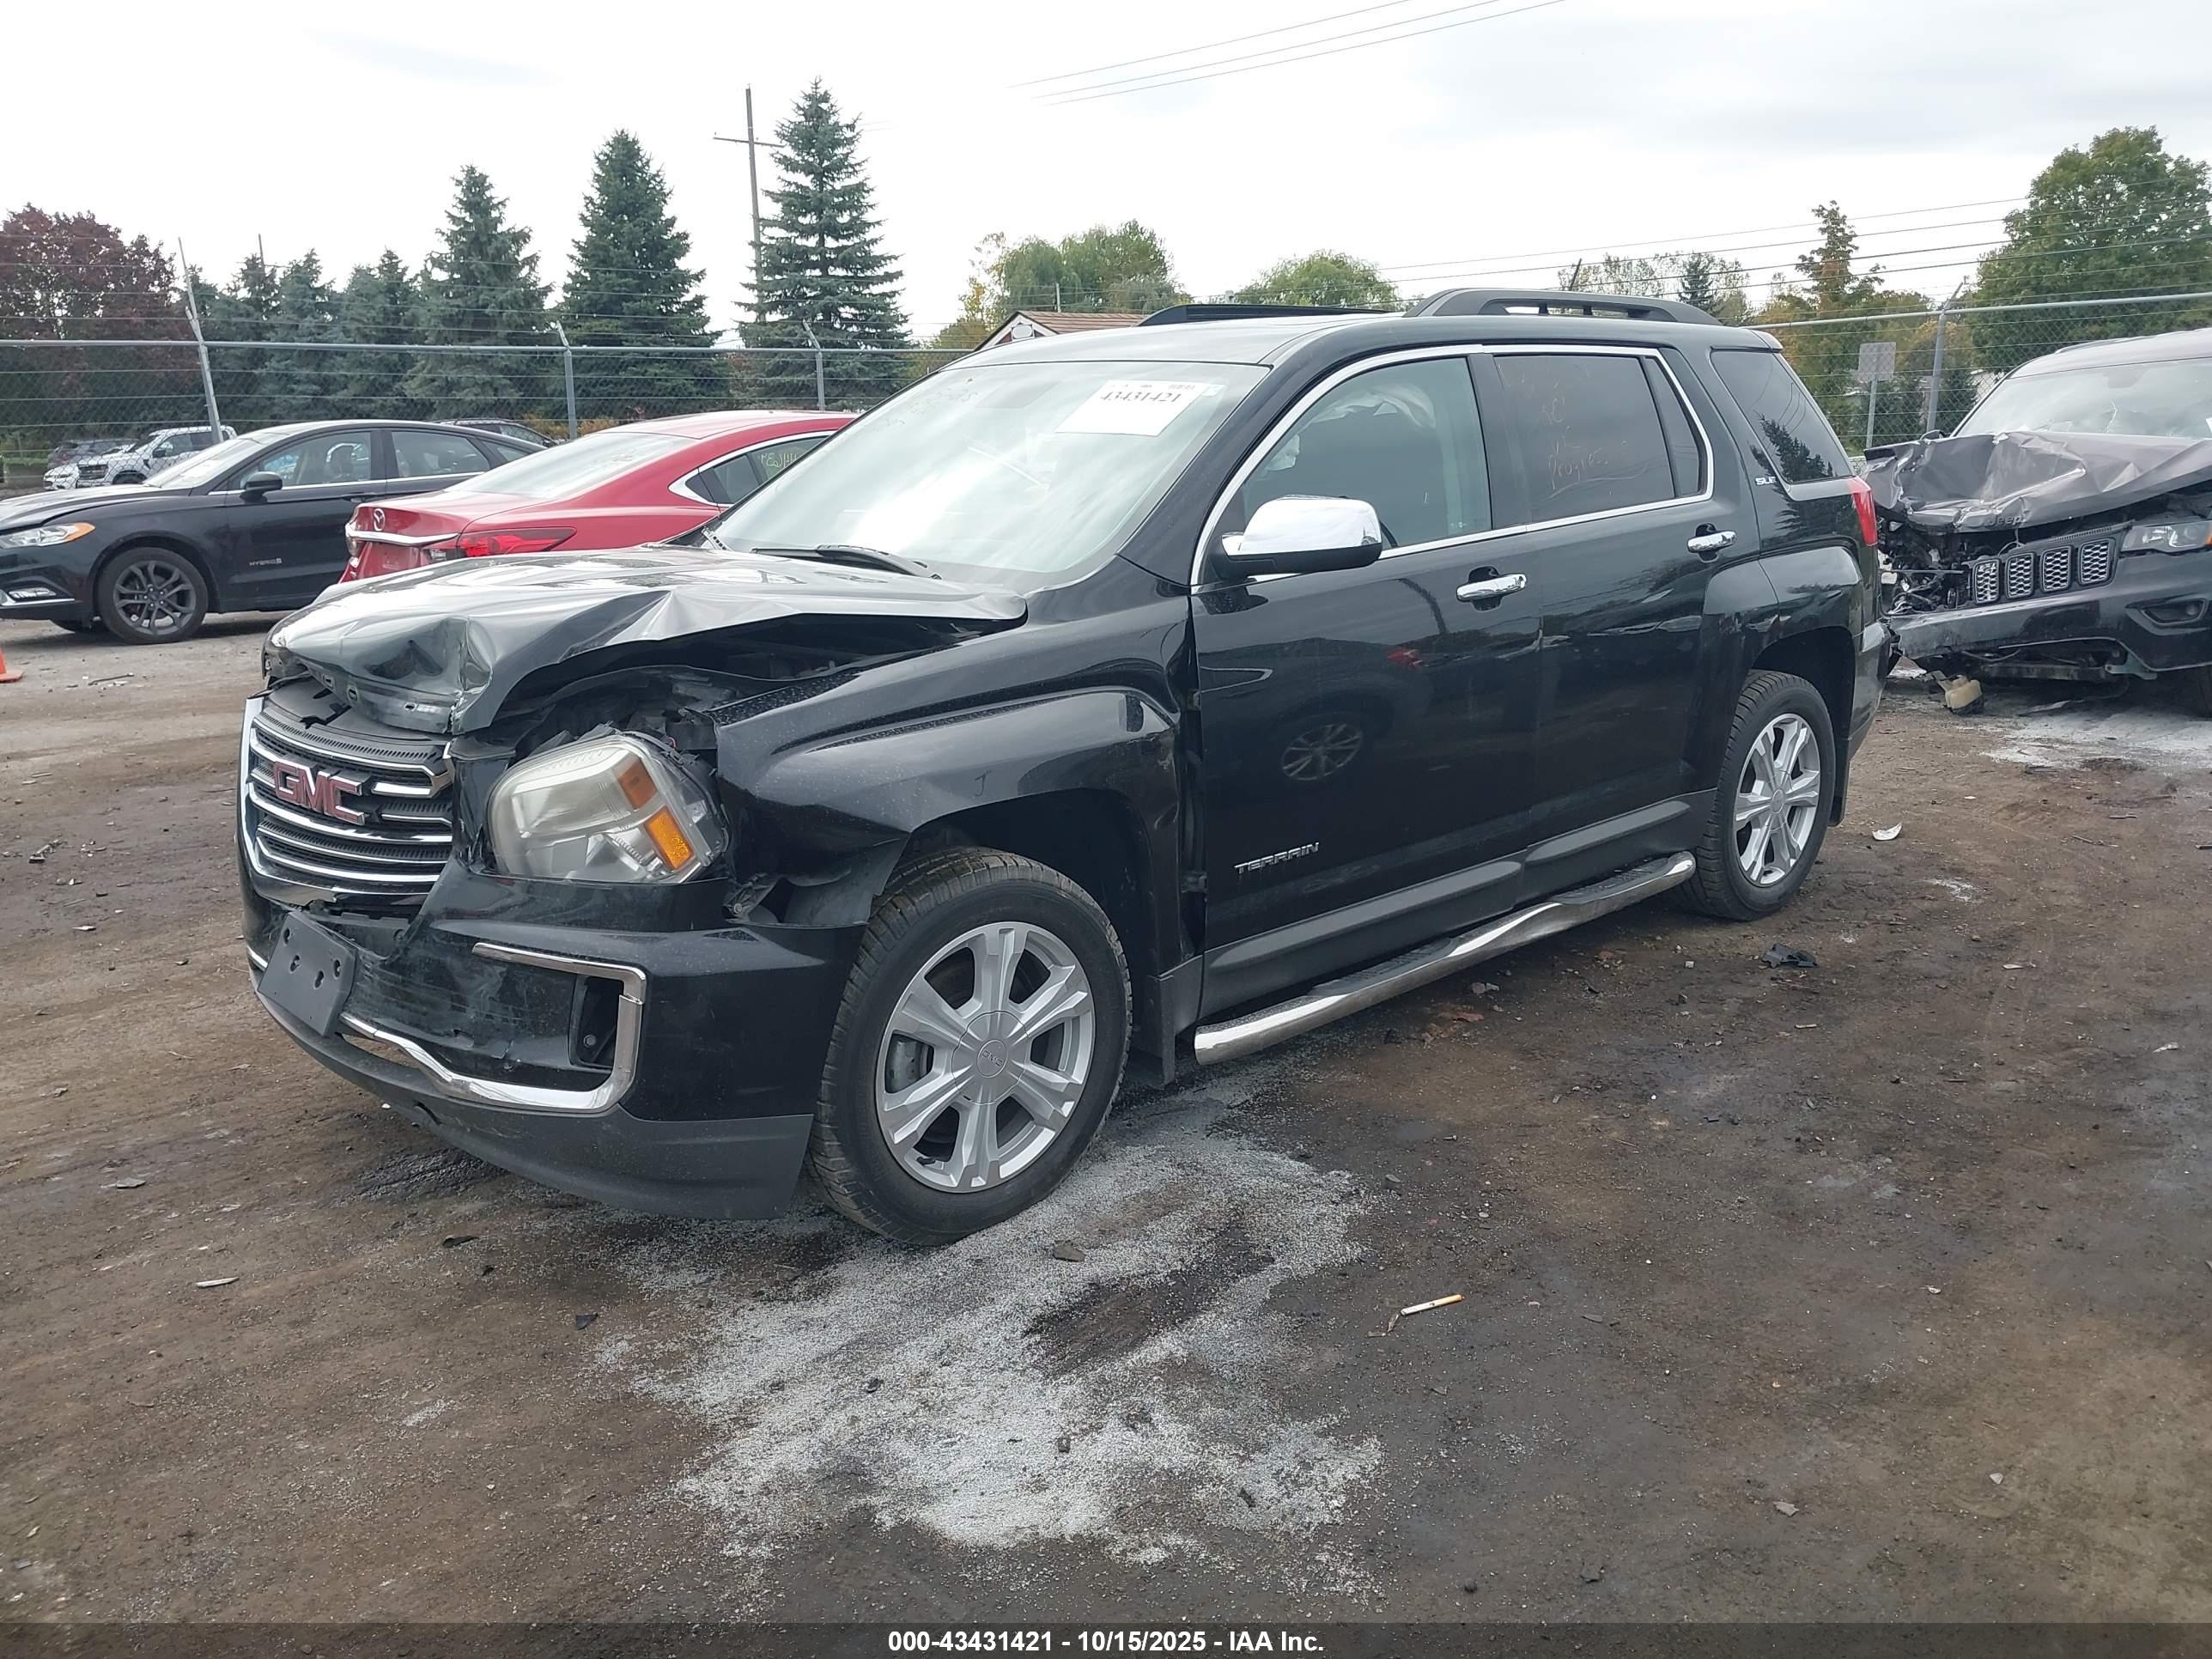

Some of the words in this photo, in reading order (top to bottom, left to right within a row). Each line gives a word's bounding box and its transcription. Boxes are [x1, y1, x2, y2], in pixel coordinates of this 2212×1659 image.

[1985, 514, 2021, 526] Jeep
[273, 760, 366, 826] GMC
[1233, 842, 1320, 874] TERRAIN
[981, 1049, 1004, 1067] GMC
